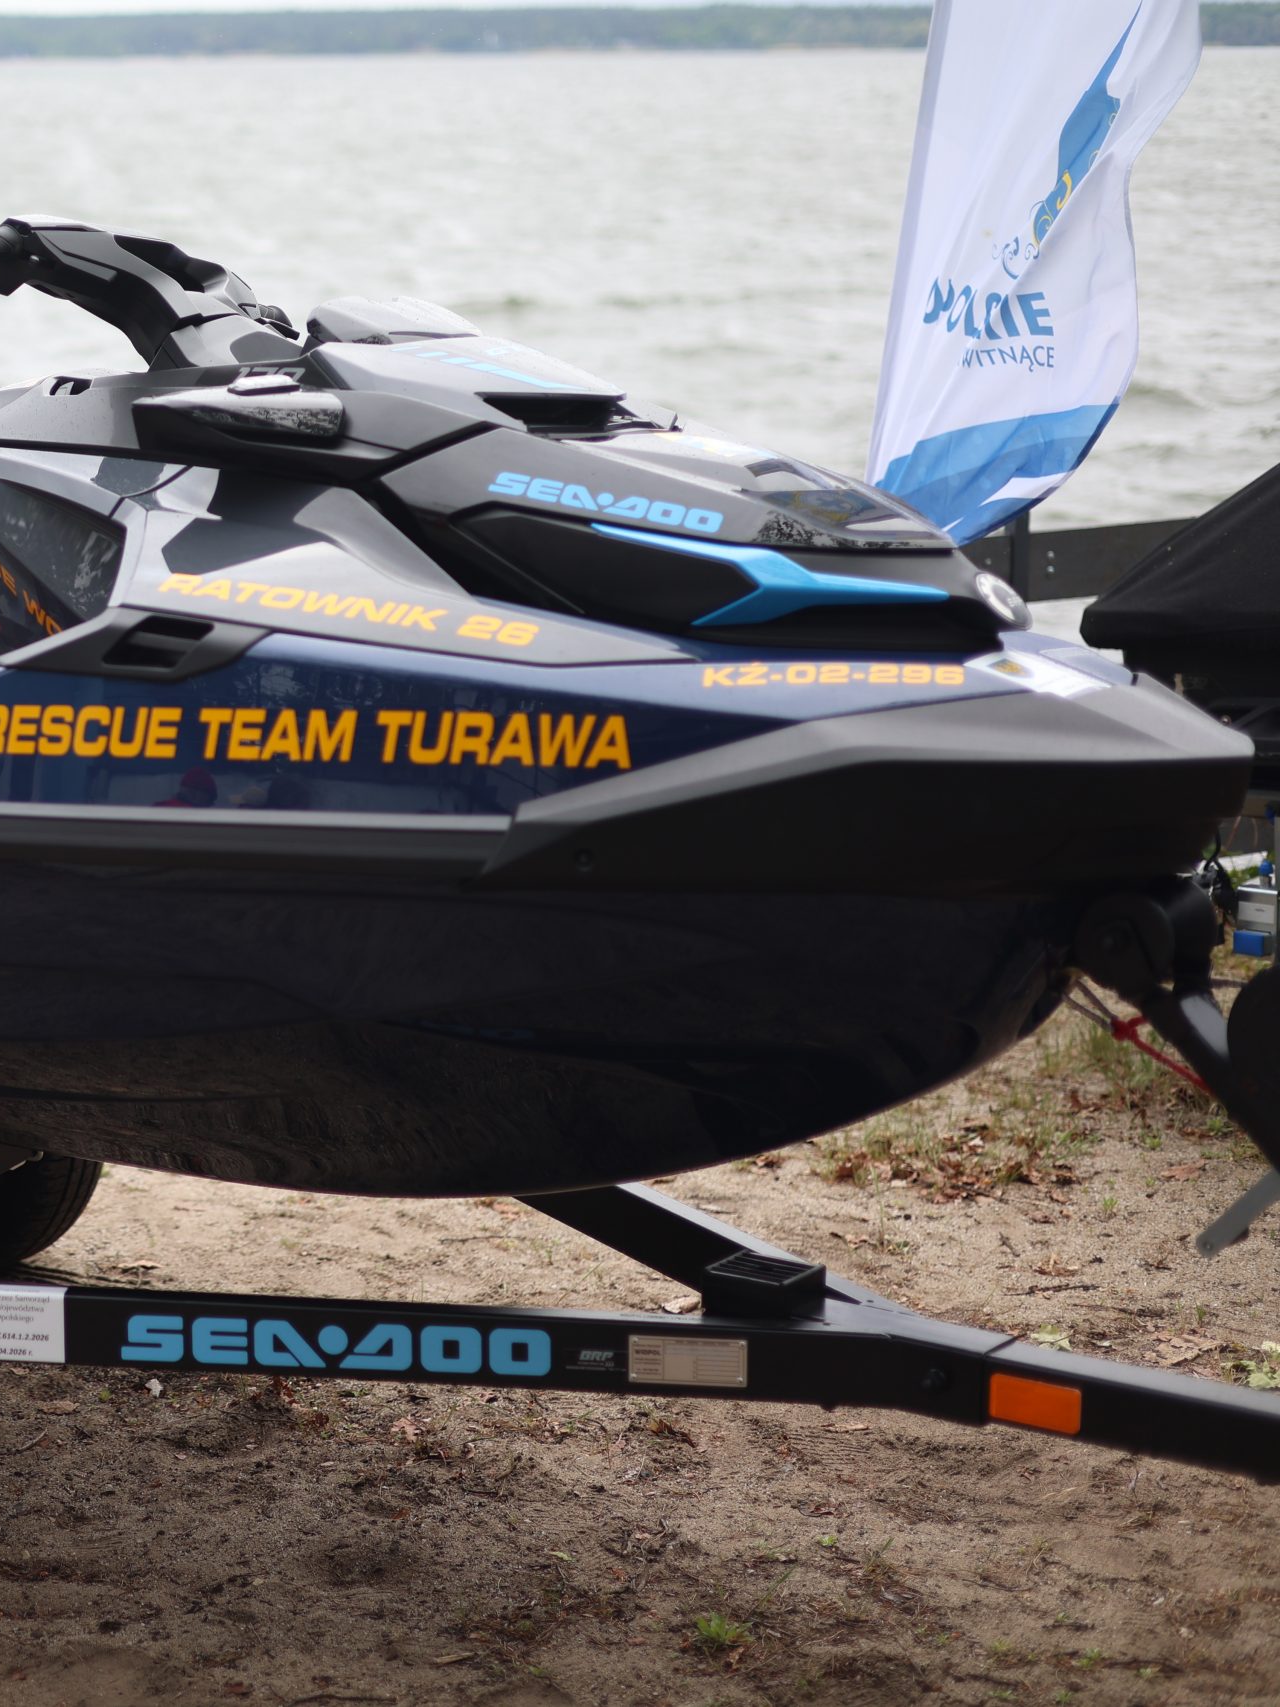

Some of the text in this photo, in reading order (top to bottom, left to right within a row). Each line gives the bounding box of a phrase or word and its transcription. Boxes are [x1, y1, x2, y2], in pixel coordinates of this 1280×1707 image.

[158, 572, 541, 647] RATOWNIK 26
[198, 708, 359, 763] TEAM
[375, 709, 632, 769] TURAWA
